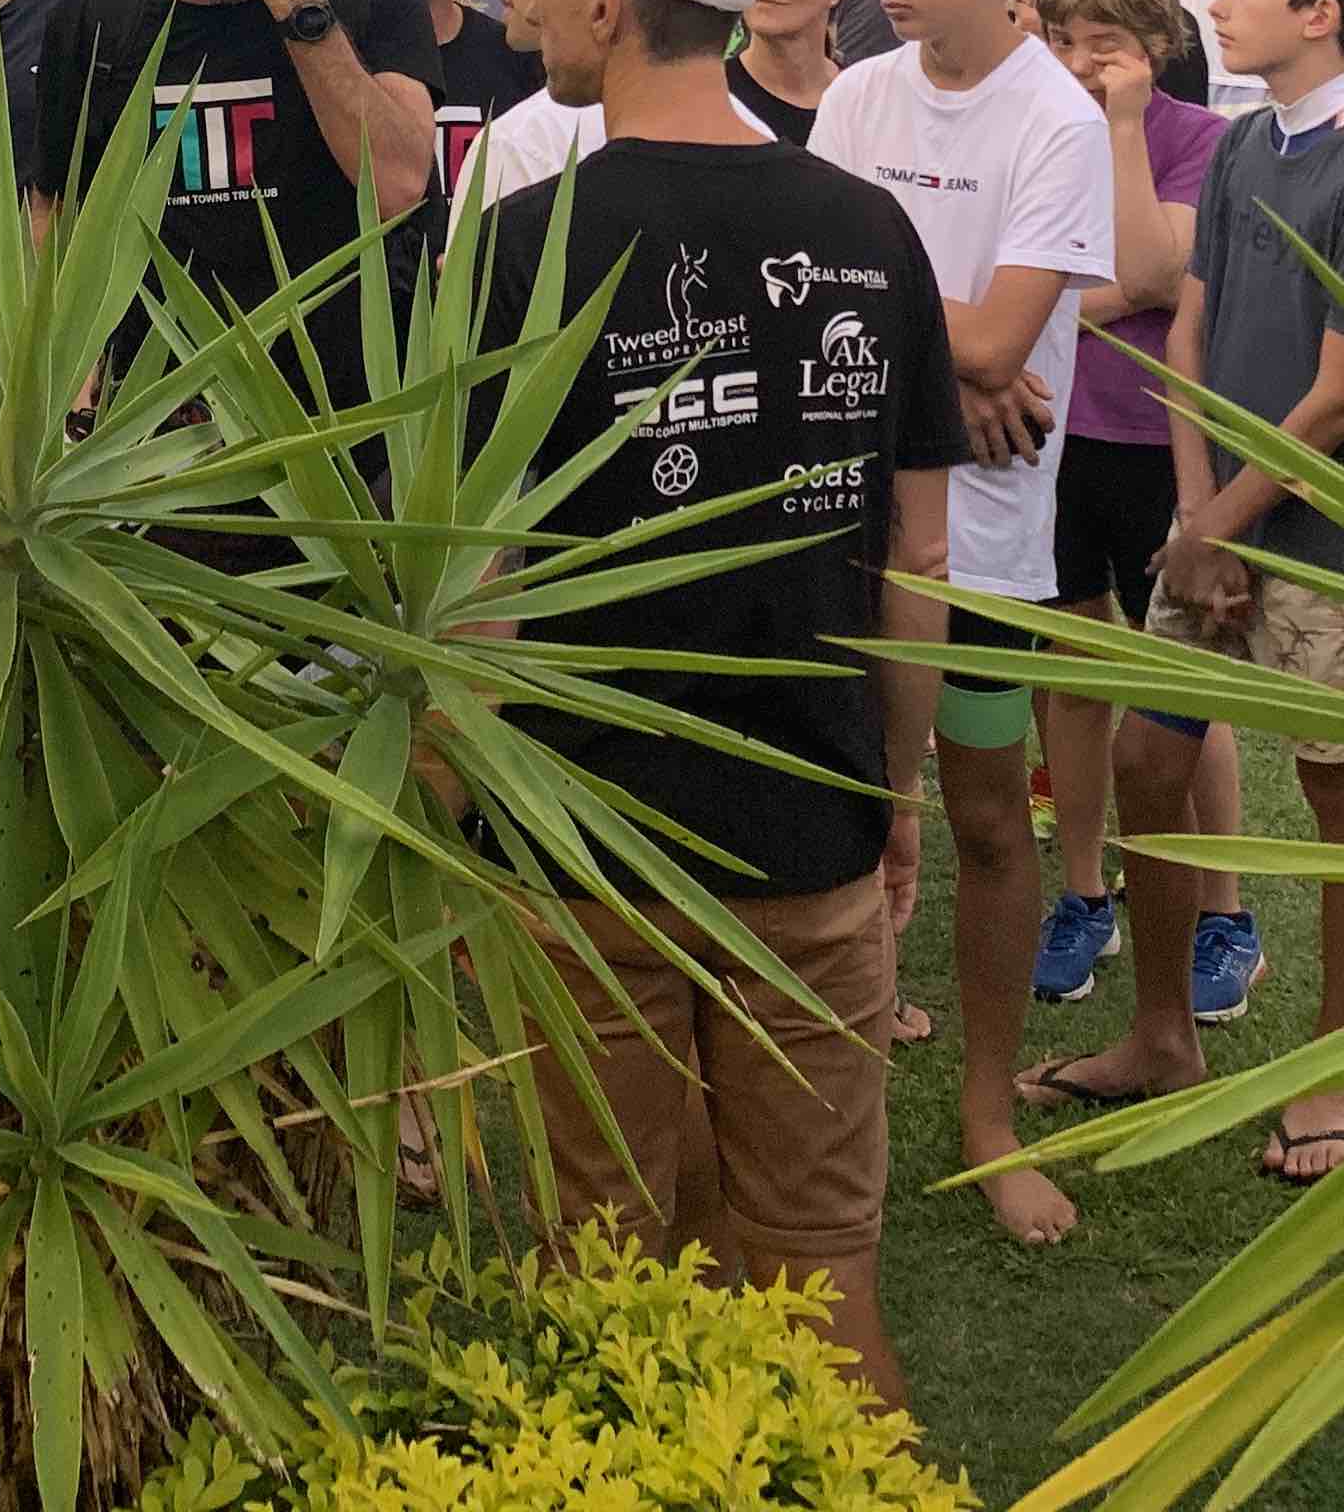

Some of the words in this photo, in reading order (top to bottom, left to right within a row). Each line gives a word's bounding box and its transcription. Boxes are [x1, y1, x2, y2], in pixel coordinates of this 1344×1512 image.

[876, 166, 915, 184] TOMM
[192, 192, 230, 204] TOWNS
[232, 190, 249, 201] TRI
[797, 266, 838, 283] IDEAL
[840, 268, 888, 285] DENTAL
[605, 320, 681, 355] Tweed
[687, 313, 748, 339] Coast
[607, 336, 751, 370] CHIROPRATIC
[830, 336, 879, 367] AK
[797, 359, 890, 408] Legal
[656, 422, 686, 439] COAST
[688, 412, 759, 432] MULTISPORT
